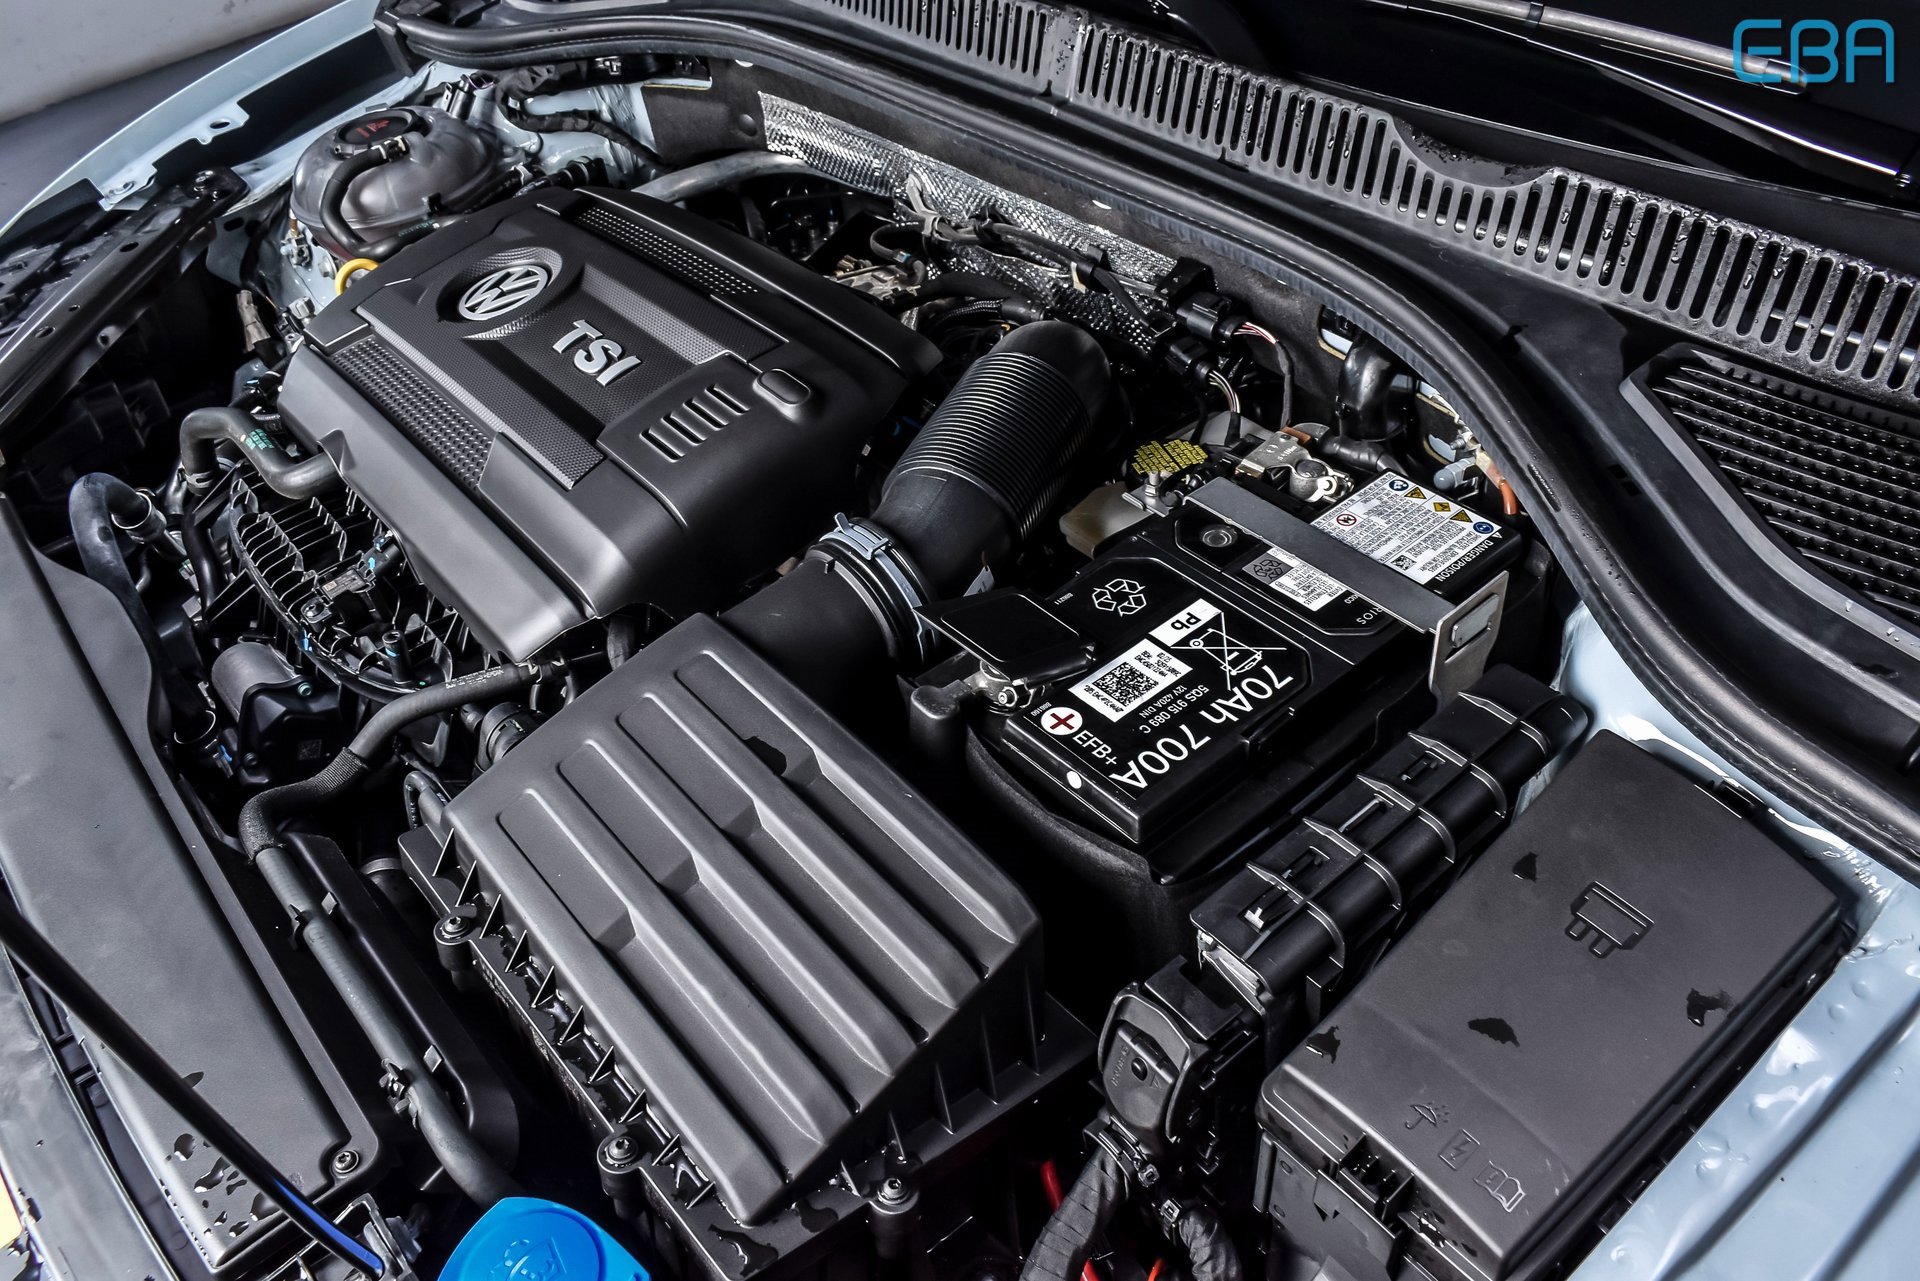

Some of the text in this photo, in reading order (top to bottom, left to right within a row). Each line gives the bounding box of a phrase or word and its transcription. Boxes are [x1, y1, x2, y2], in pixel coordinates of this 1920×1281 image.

[553, 319, 641, 386] TSI
[1435, 539, 1494, 582] DANGER/POISON
[1171, 612, 1202, 631] Pb
[1139, 684, 1188, 718] 12V 420A DIN
[1139, 684, 1210, 734] 5QS 915 089 C
[1072, 730, 1117, 765] EFB+
[1108, 665, 1294, 788] 70Ah 700A
